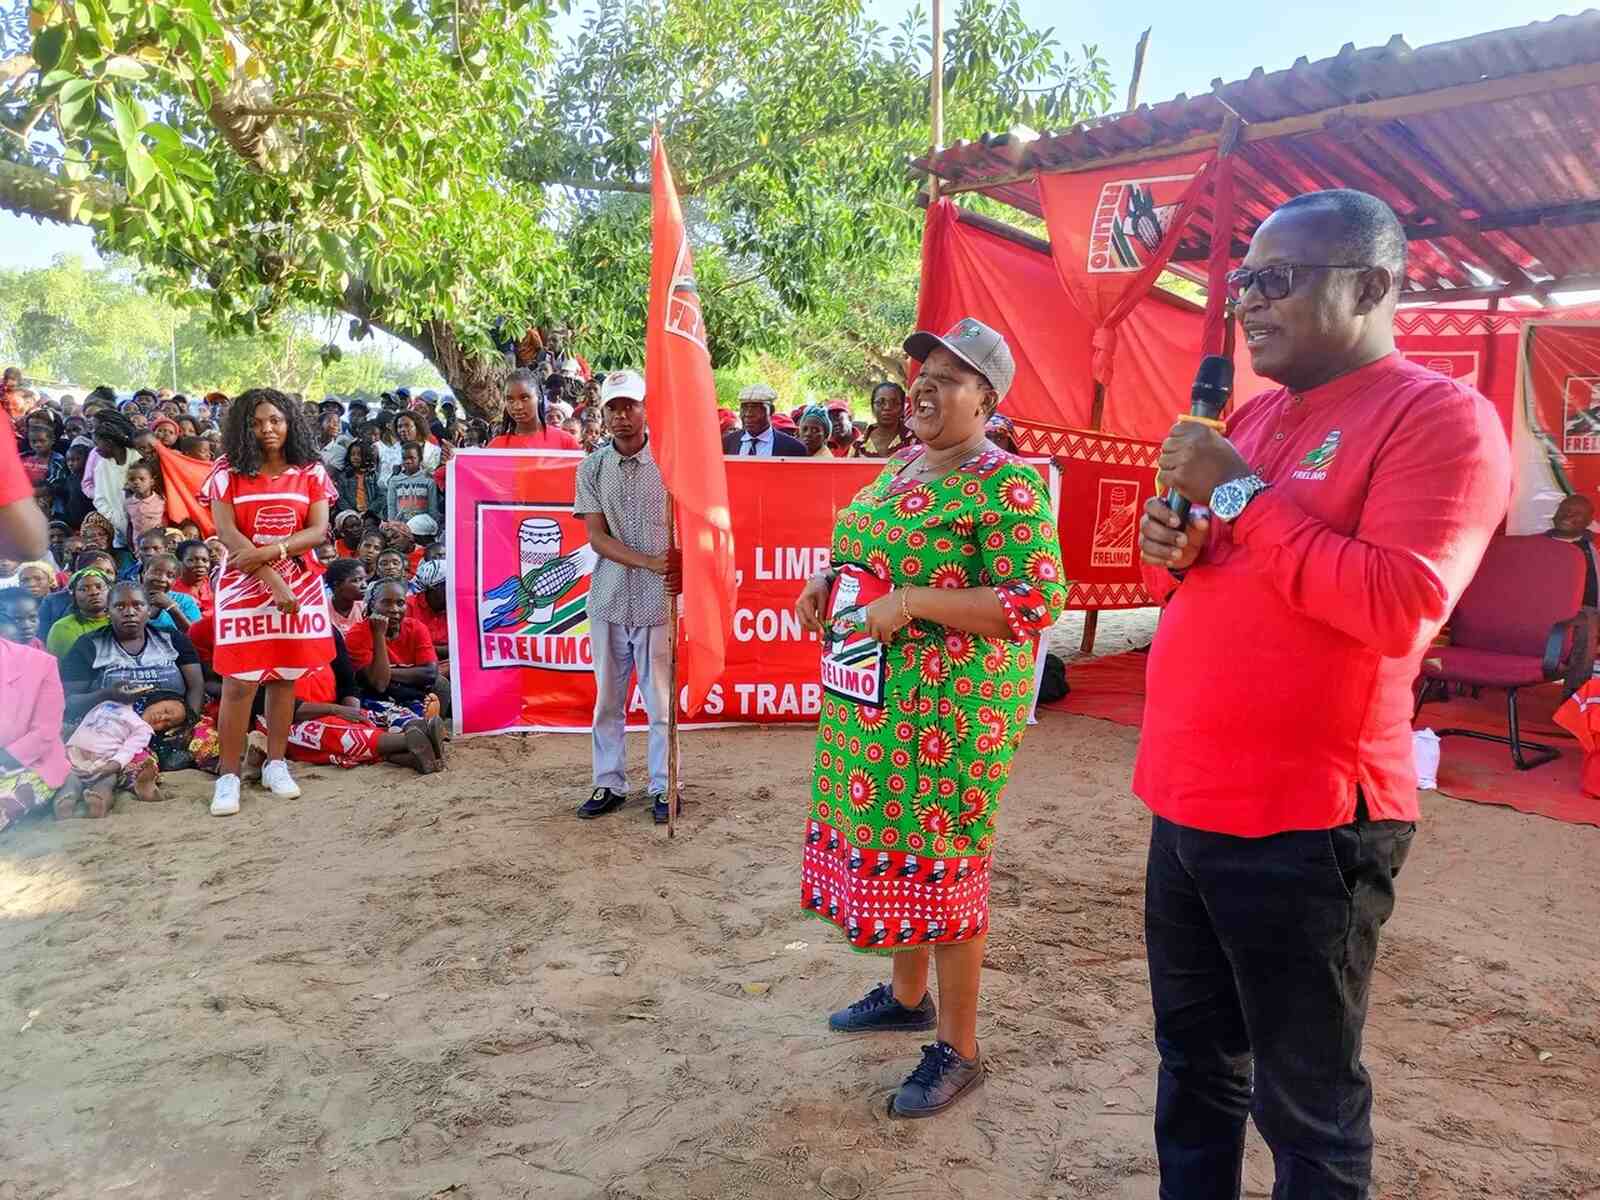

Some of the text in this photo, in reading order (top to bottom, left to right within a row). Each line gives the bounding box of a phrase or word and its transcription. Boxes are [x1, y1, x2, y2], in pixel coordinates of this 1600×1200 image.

[1093, 551, 1130, 564] FRELIMO
[220, 612, 325, 639] FRELIMO
[733, 608, 816, 642] CON
[483, 635, 593, 664] FRELIMO
